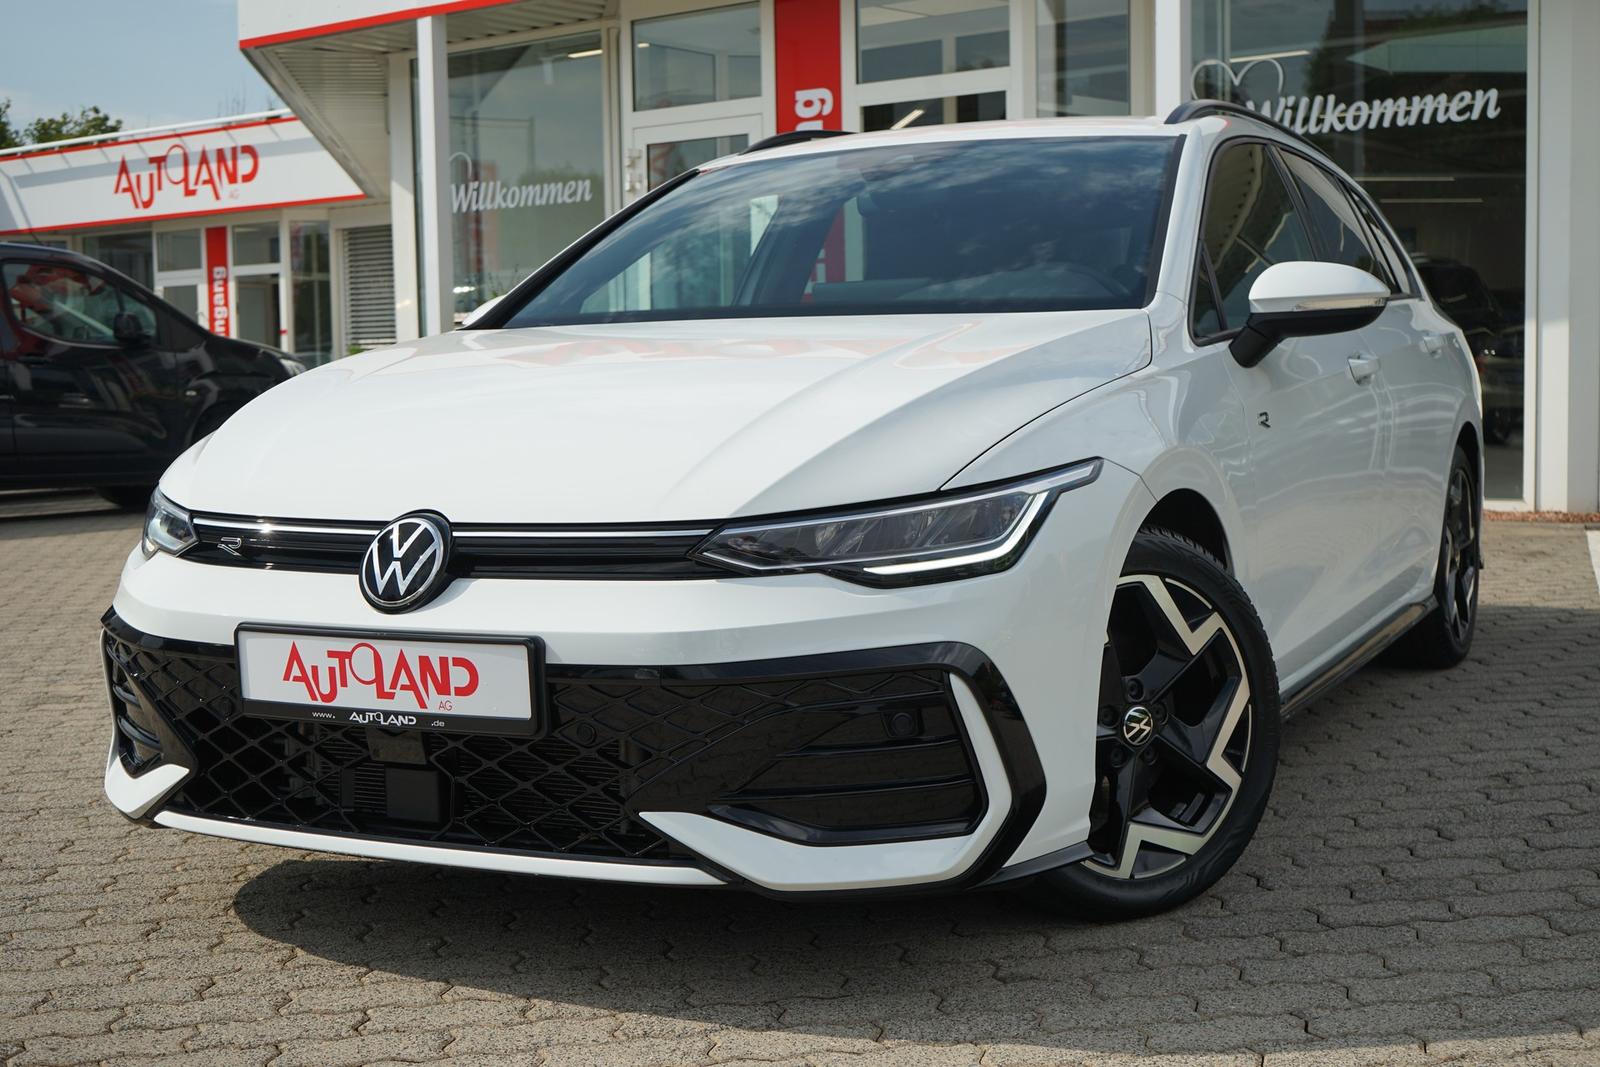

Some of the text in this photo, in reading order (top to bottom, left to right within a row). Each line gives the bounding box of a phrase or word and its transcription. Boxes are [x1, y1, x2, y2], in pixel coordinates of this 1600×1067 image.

[114, 144, 259, 209] AUTOLAND
[451, 179, 593, 214] Willkommen
[283, 640, 479, 709] AUTOLAND
[312, 711, 336, 719] www.
[349, 711, 417, 726] AUTOLAND
[438, 700, 453, 711] AG
